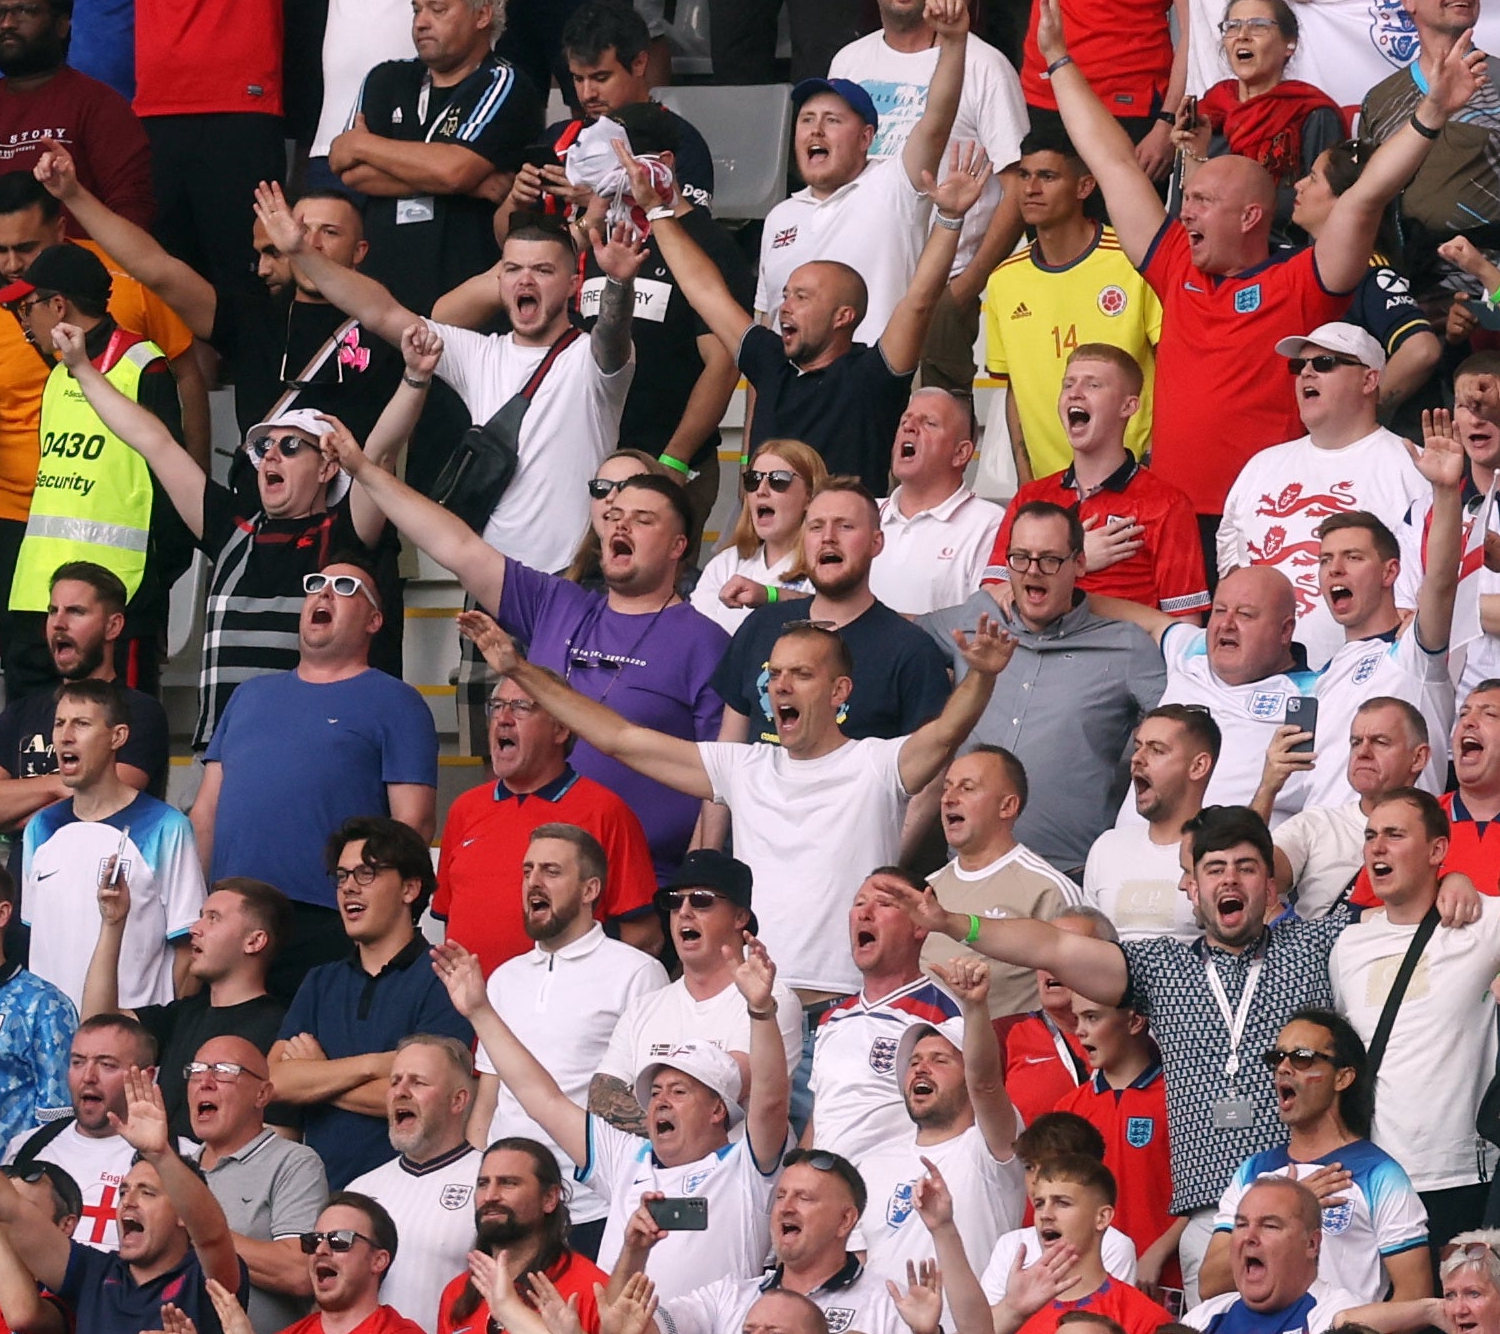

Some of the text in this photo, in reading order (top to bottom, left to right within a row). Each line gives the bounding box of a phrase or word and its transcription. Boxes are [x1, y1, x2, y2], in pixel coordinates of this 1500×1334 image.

[9, 128, 67, 145] STORY
[1052, 324, 1078, 358] 14
[42, 431, 106, 461] 0430
[100, 1171, 124, 1185] Engl
